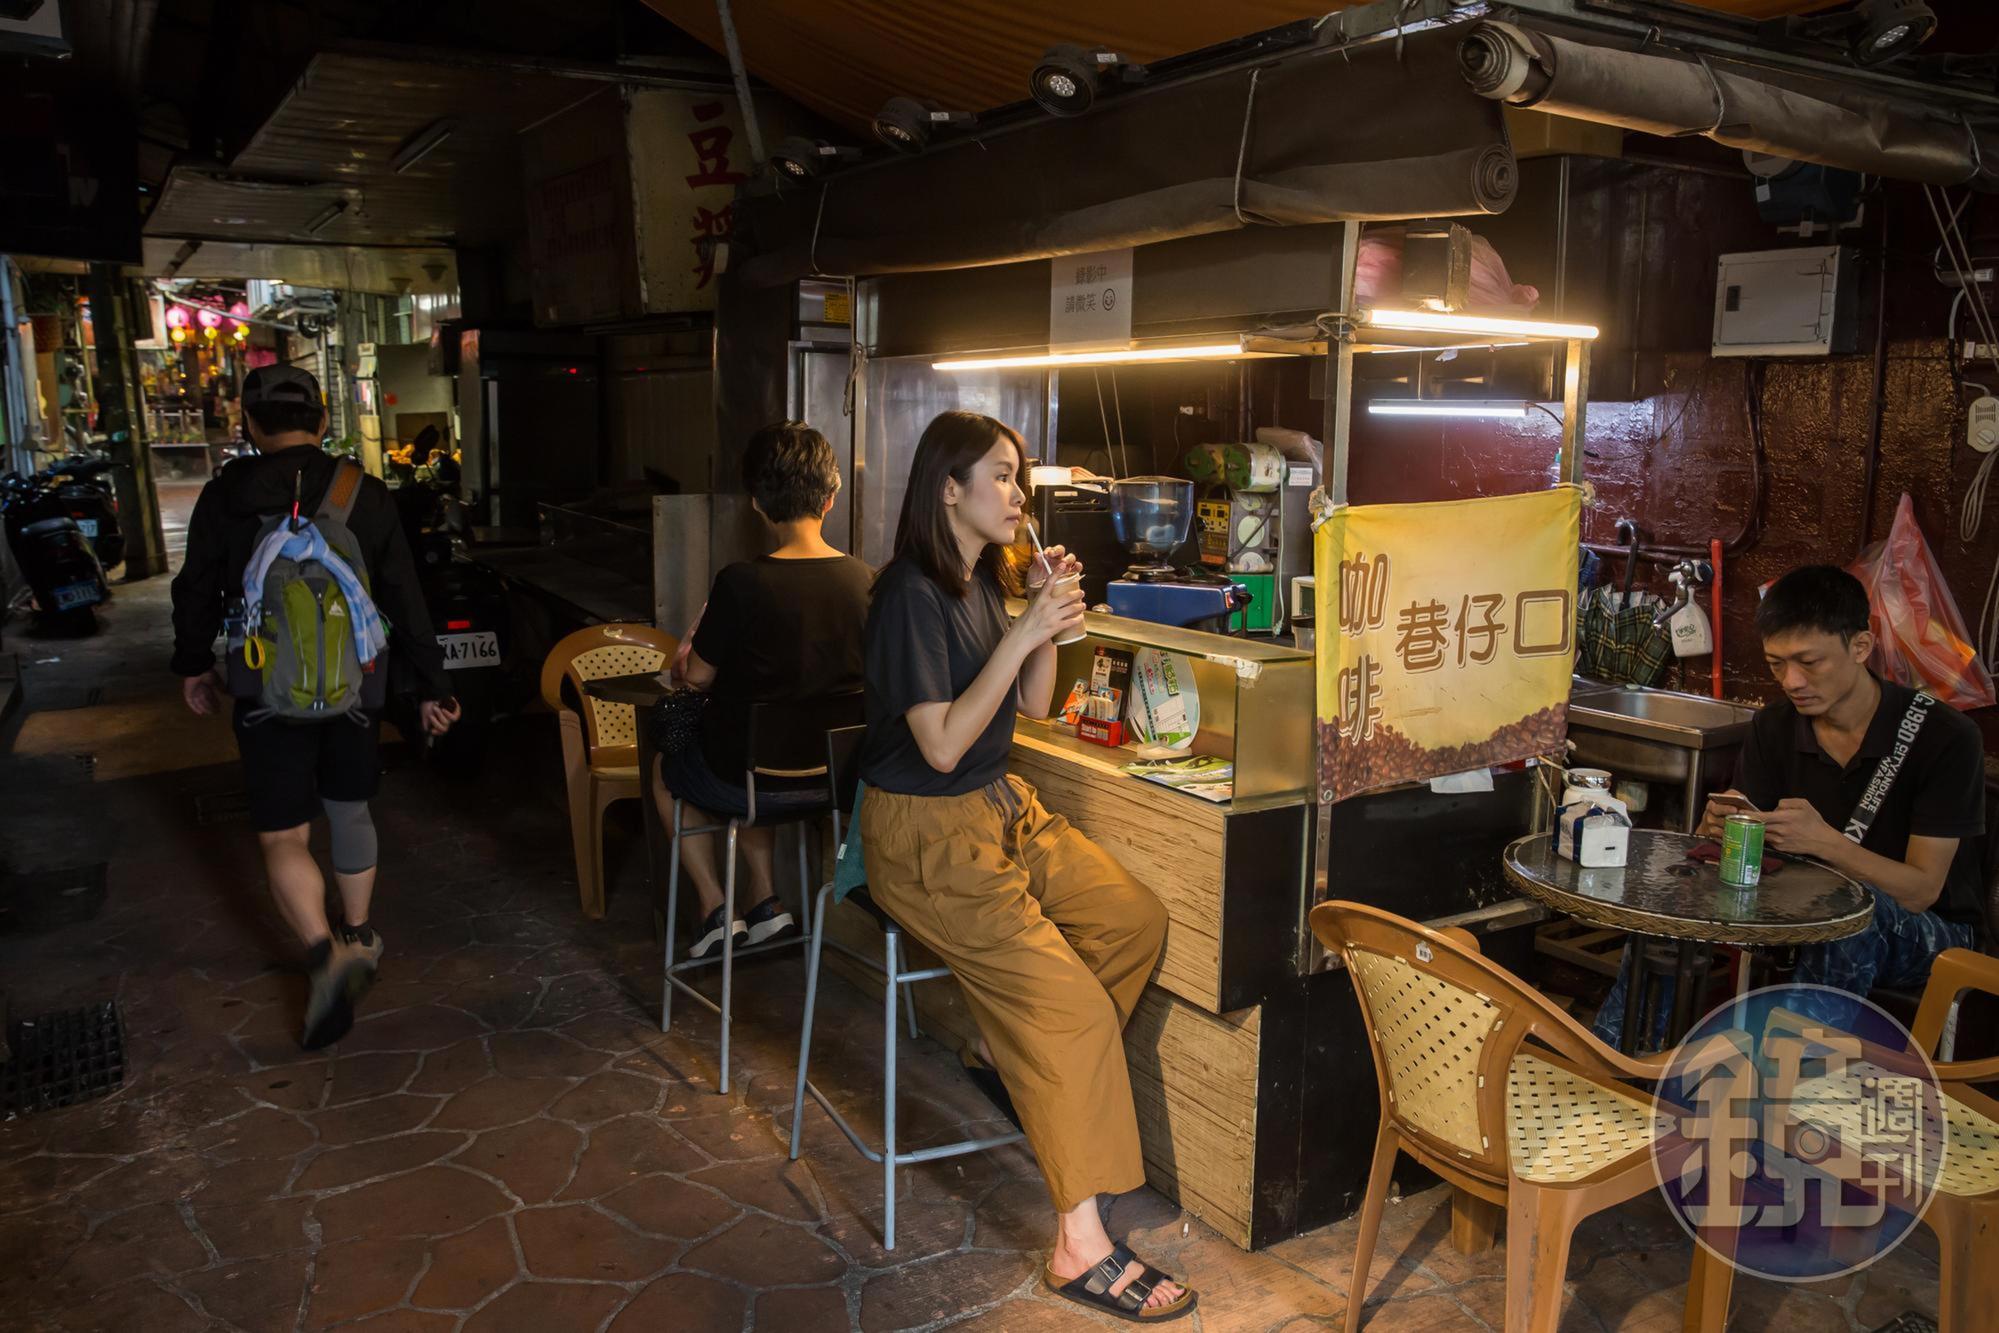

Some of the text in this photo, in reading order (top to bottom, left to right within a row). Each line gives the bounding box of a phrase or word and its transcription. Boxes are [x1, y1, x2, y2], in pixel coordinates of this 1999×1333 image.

[1064, 294, 1097, 313] 請微笑
[1338, 552, 1391, 744] 咖啡
[1395, 589, 1572, 674] 巷仔口
